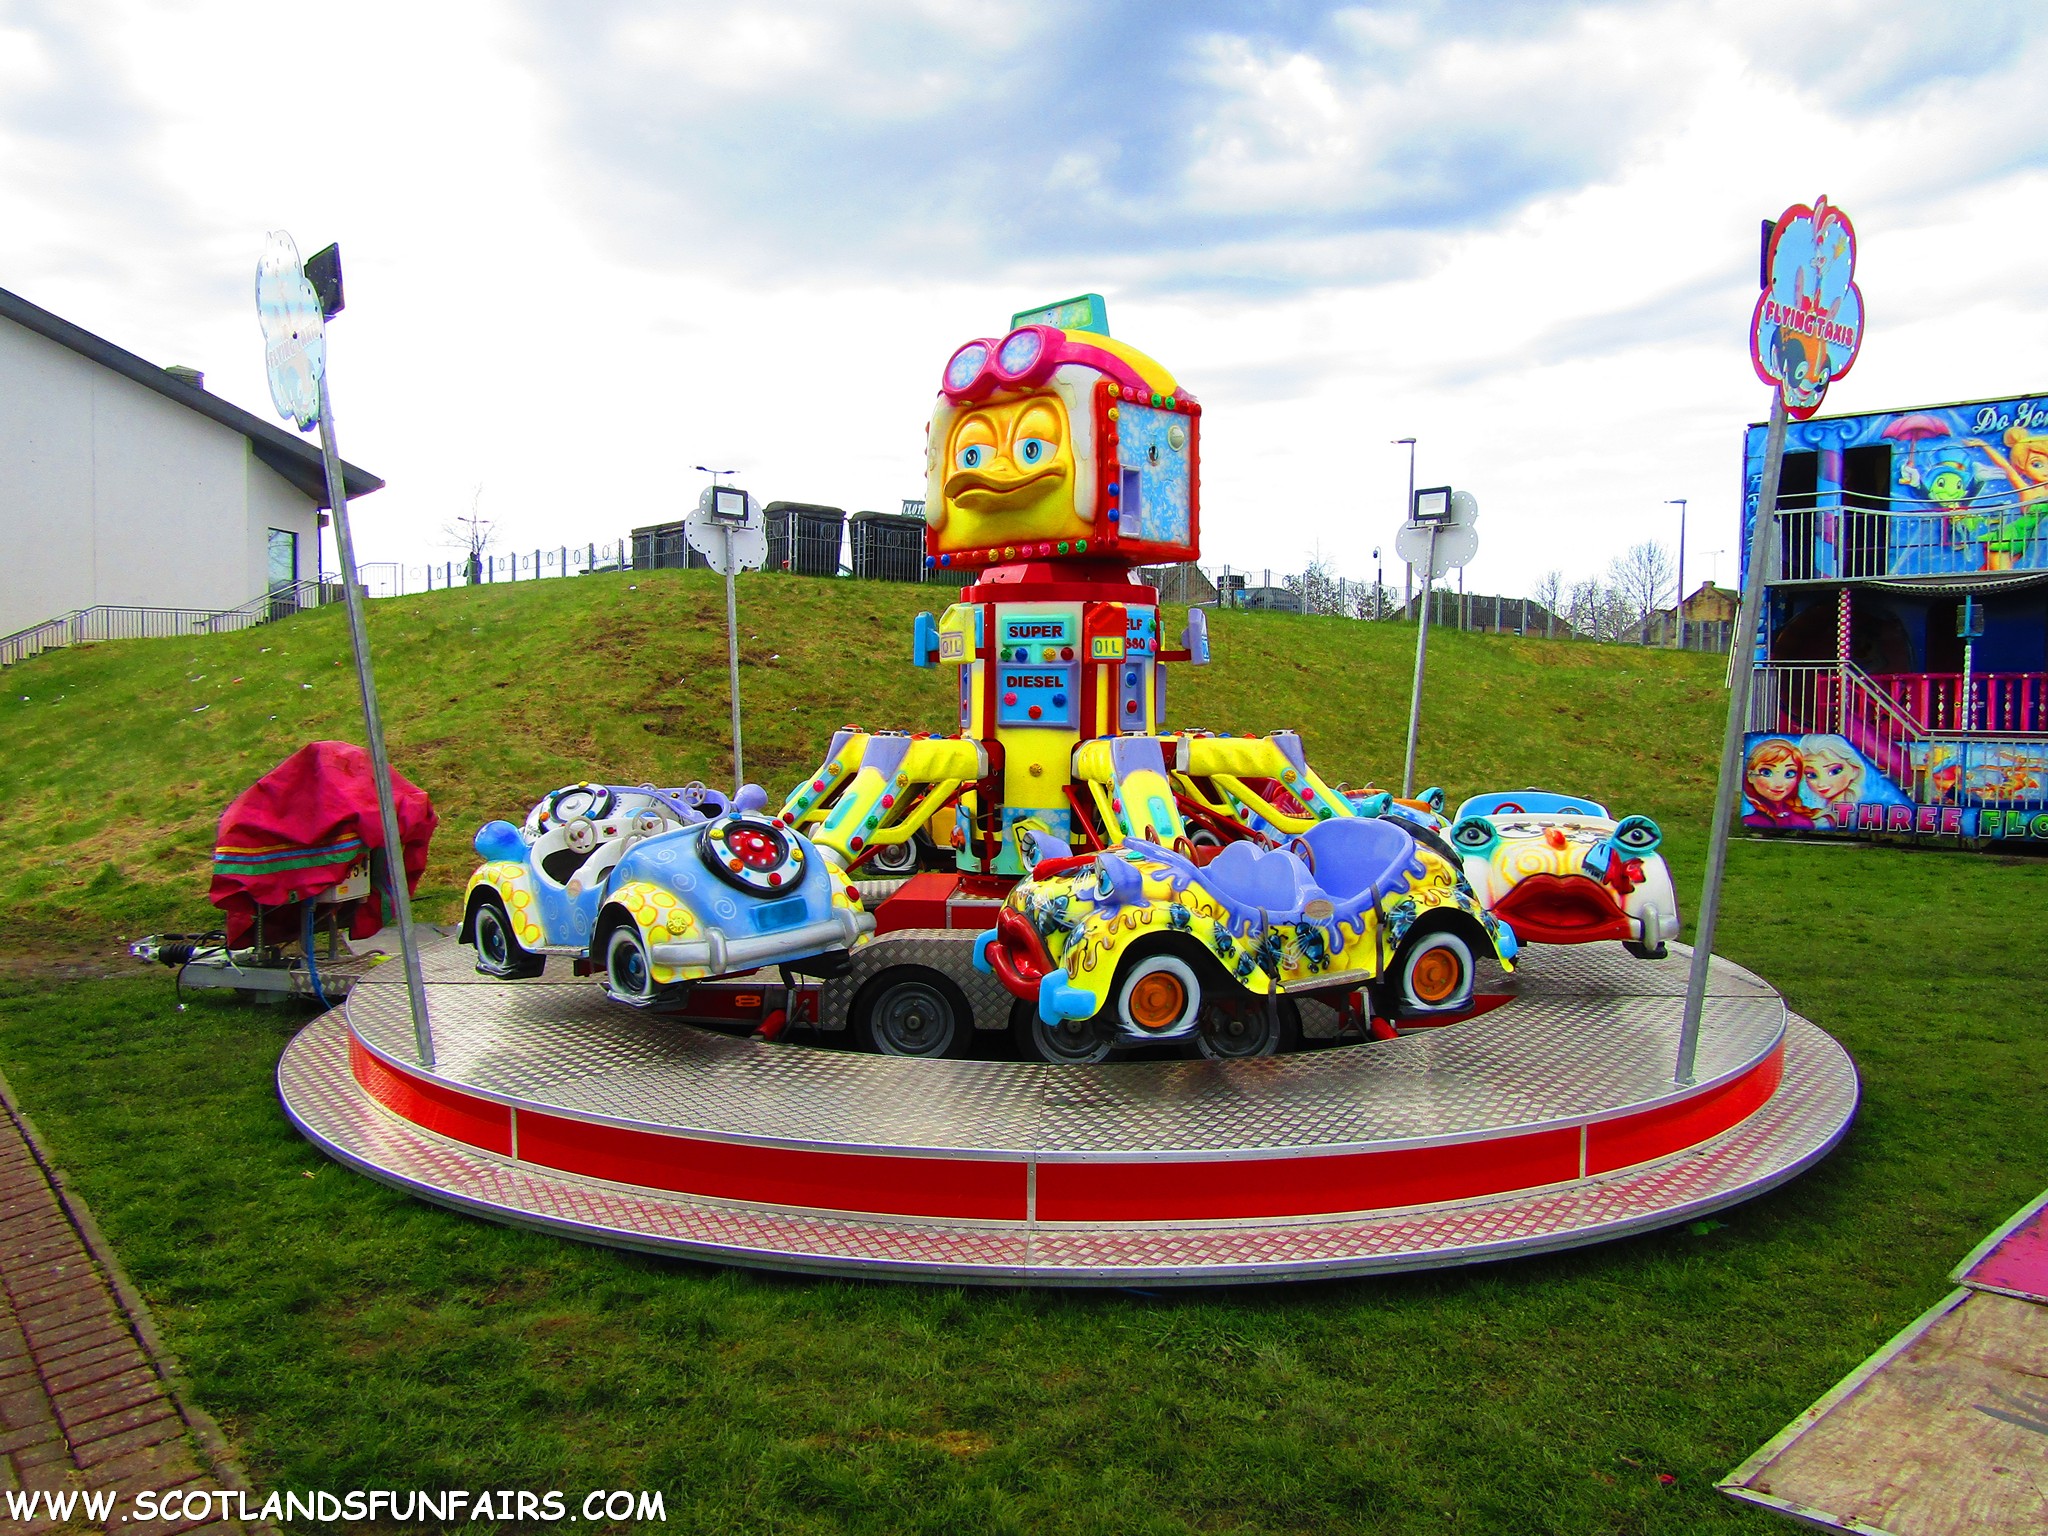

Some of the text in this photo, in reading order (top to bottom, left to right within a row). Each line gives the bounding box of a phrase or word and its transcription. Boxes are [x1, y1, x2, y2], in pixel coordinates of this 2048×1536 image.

[1764, 300, 1855, 348] FLYING TAXIS
[1972, 406, 2010, 434] Do
[1008, 625, 1063, 639] SUPER
[942, 640, 962, 654] OIL
[1094, 640, 1120, 654] OIL
[1006, 675, 1064, 689] DIESEL
[1833, 802, 1963, 835] THREE
